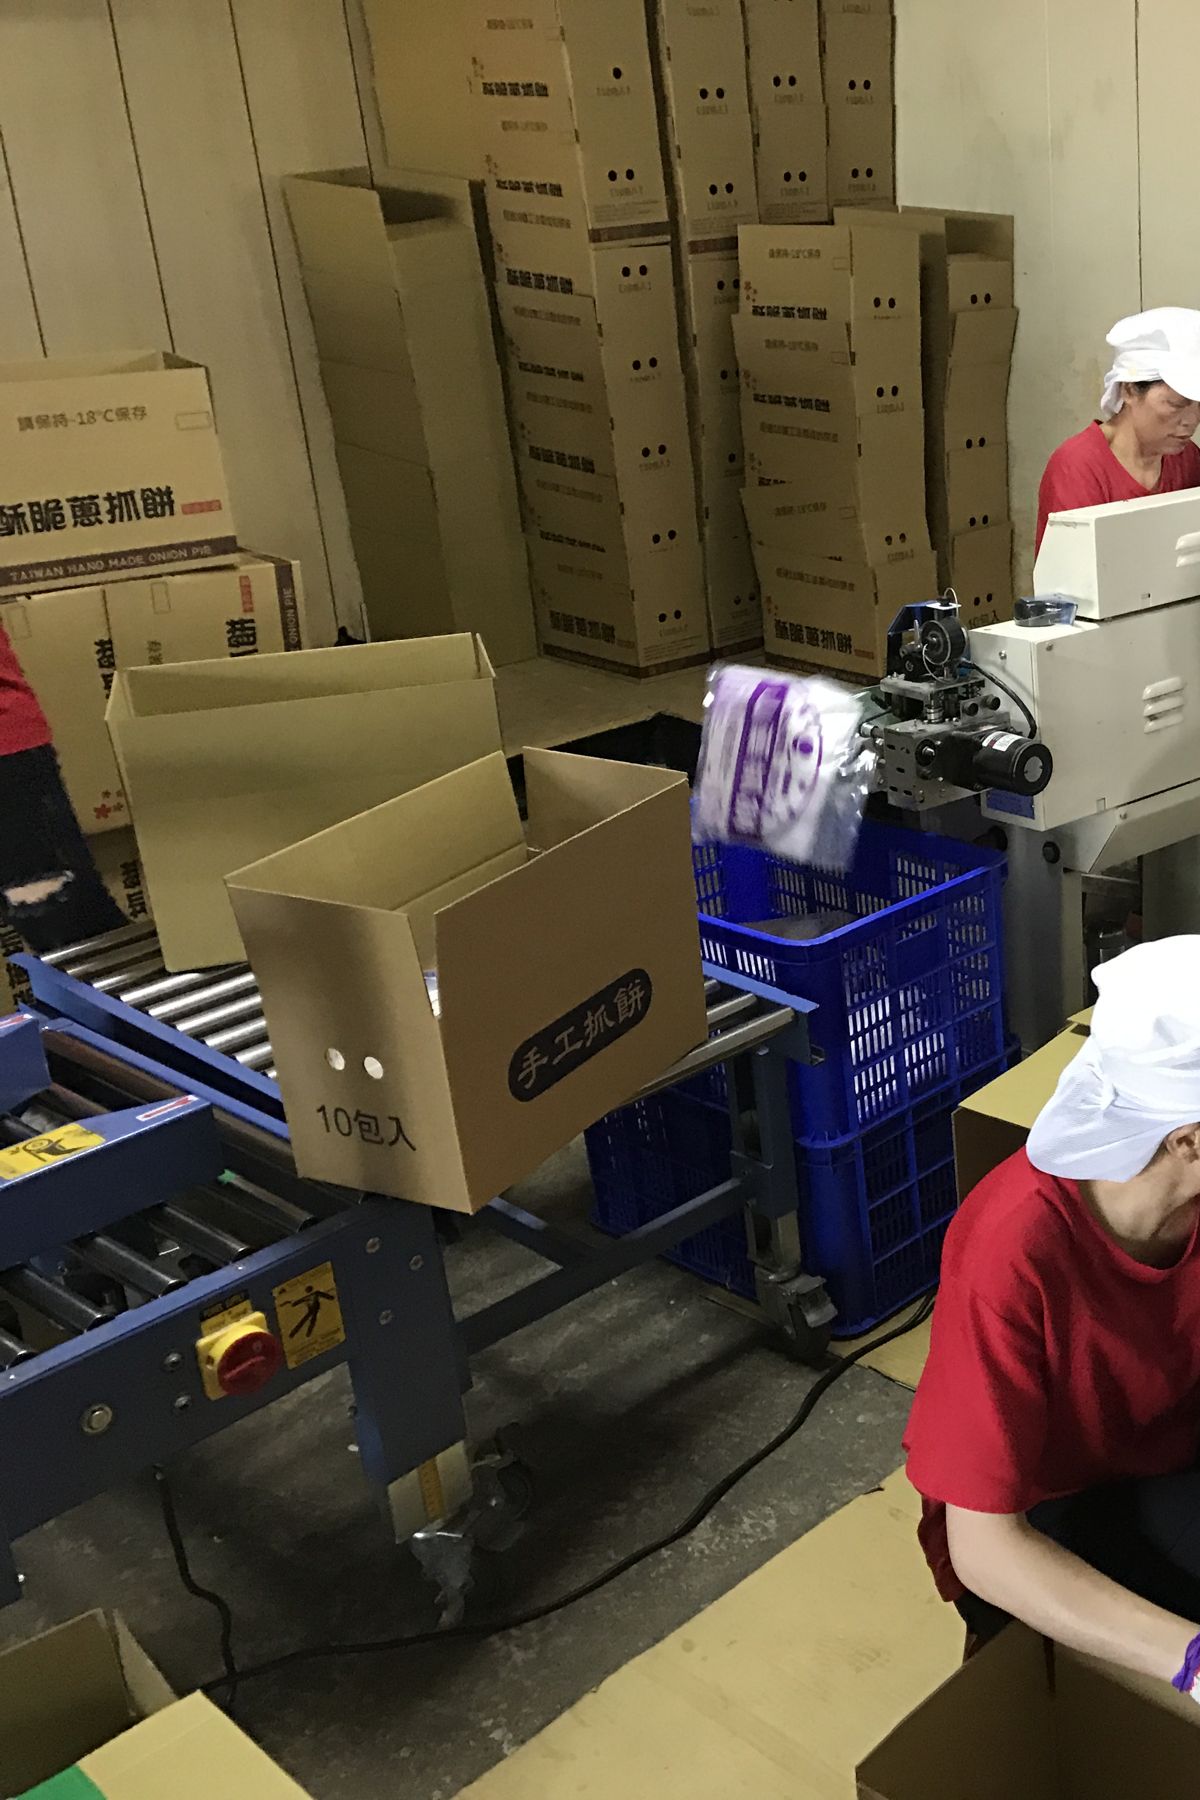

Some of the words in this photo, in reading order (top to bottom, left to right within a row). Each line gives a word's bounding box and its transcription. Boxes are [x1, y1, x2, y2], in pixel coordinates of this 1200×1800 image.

[9, 566, 65, 582] TAIWAN
[67, 560, 105, 575] HAND
[108, 554, 146, 569] MADE
[149, 549, 189, 564] ONION
[191, 545, 212, 559] PIE
[283, 587, 295, 607] PIE
[283, 609, 299, 645] ONION
[517, 978, 646, 1090] 手工抓餅
[315, 1103, 417, 1152] 10包入
